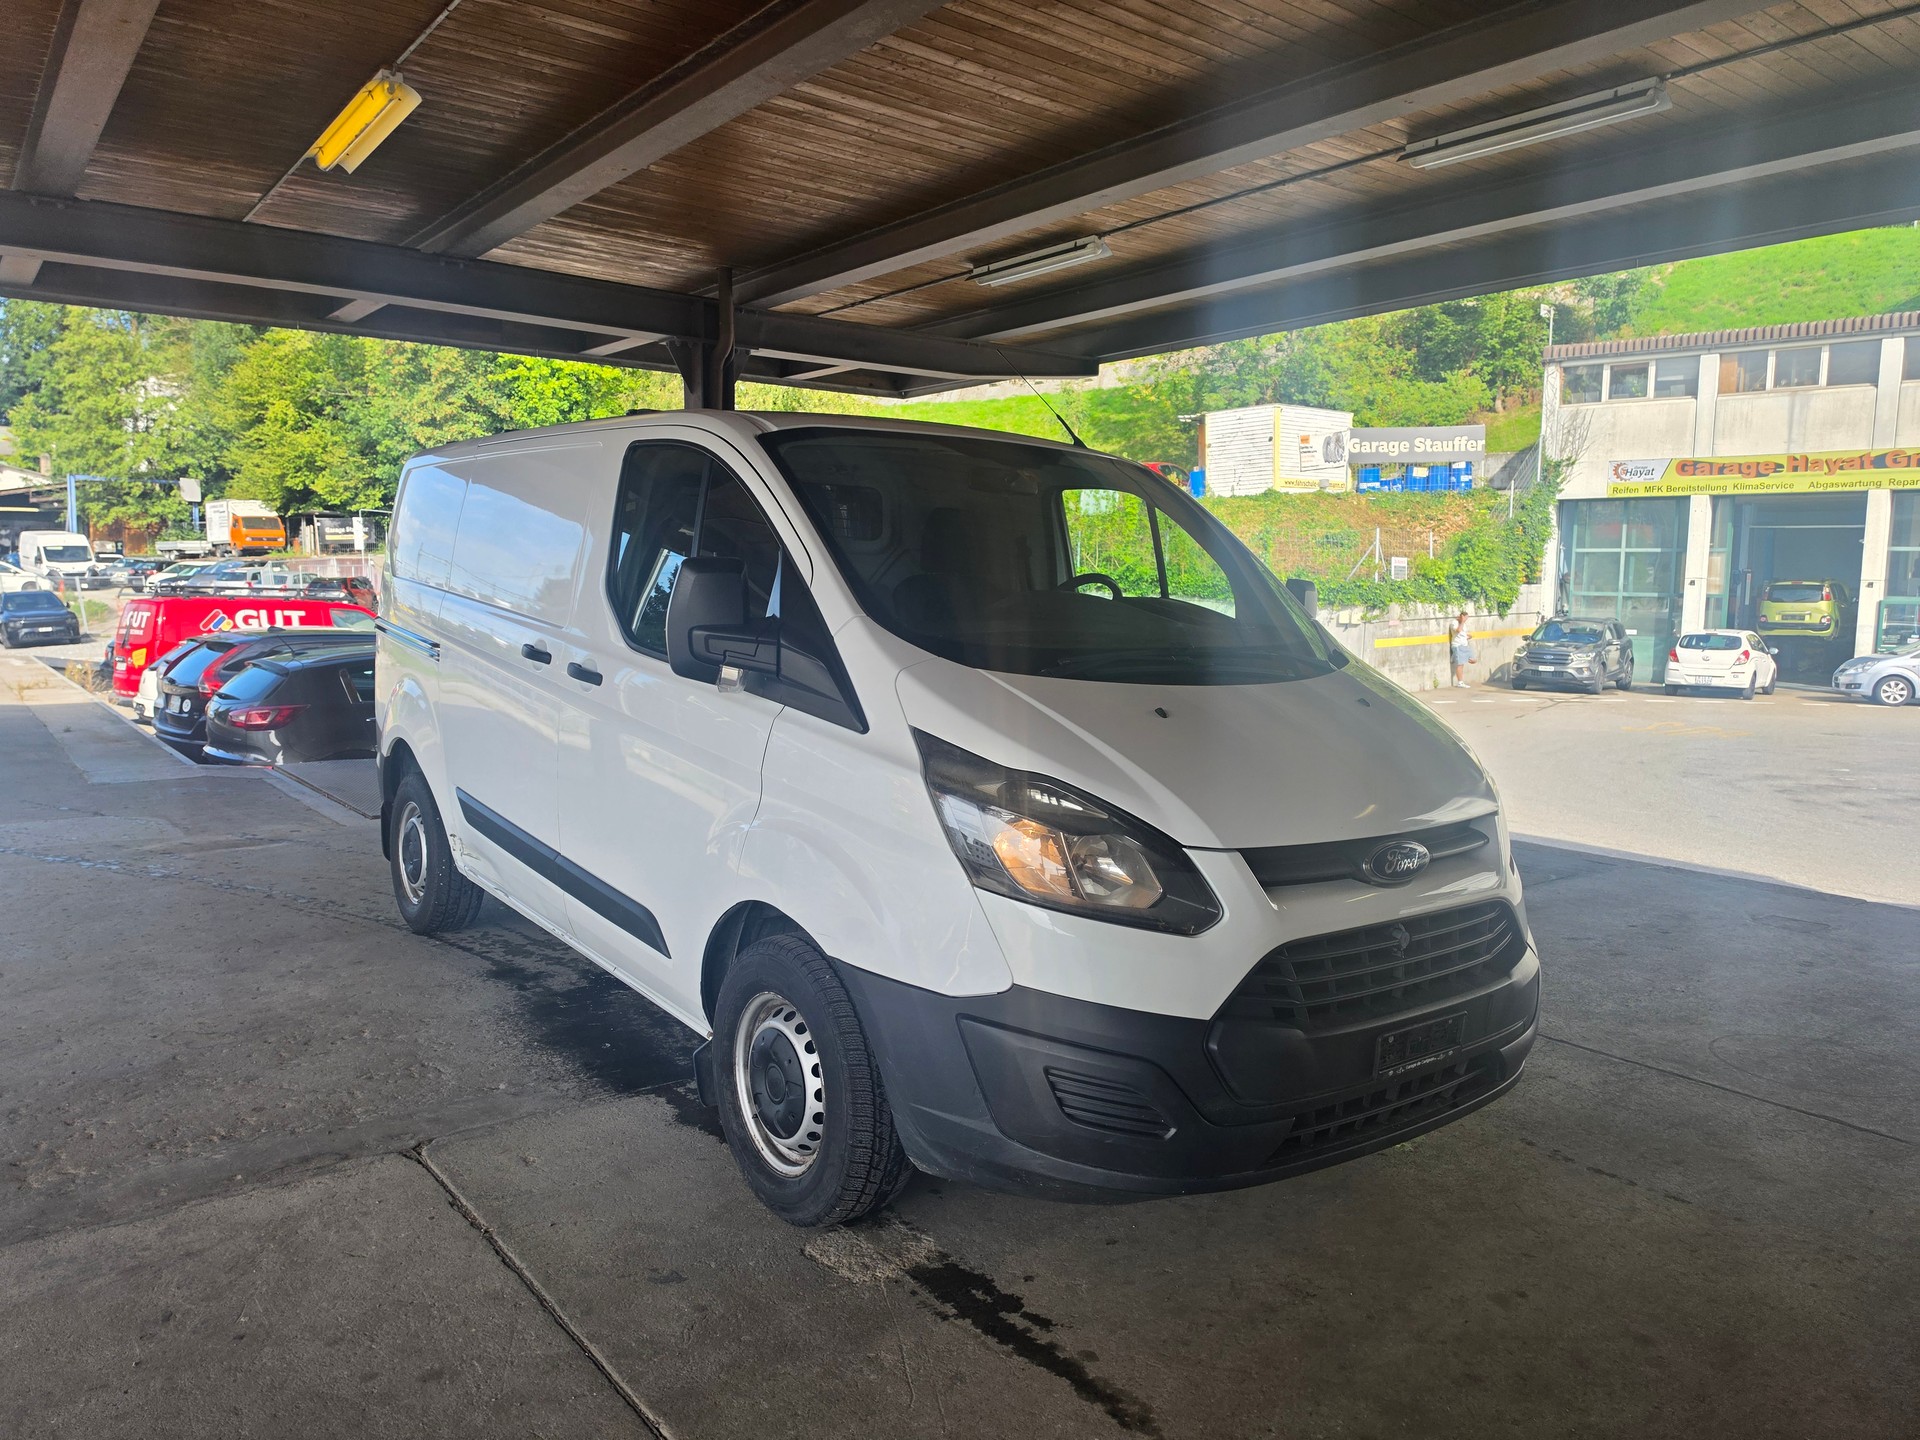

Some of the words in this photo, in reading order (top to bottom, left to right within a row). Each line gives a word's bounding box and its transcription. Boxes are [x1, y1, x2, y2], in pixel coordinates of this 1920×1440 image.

[1349, 438, 1410, 457] Garage
[1414, 436, 1486, 453] Stauffer
[1625, 468, 1655, 479] Hayat
[1675, 459, 1777, 479] Garage
[1785, 452, 1875, 476] Hayat
[1612, 486, 1639, 495] Reifen
[1644, 485, 1664, 494] MFK
[1666, 483, 1728, 493] Bereitstellung
[1733, 482, 1795, 491] KlimaService
[1808, 479, 1882, 490] Abgaswartung
[234, 609, 306, 629] GUT
[1384, 848, 1419, 874] Ford
